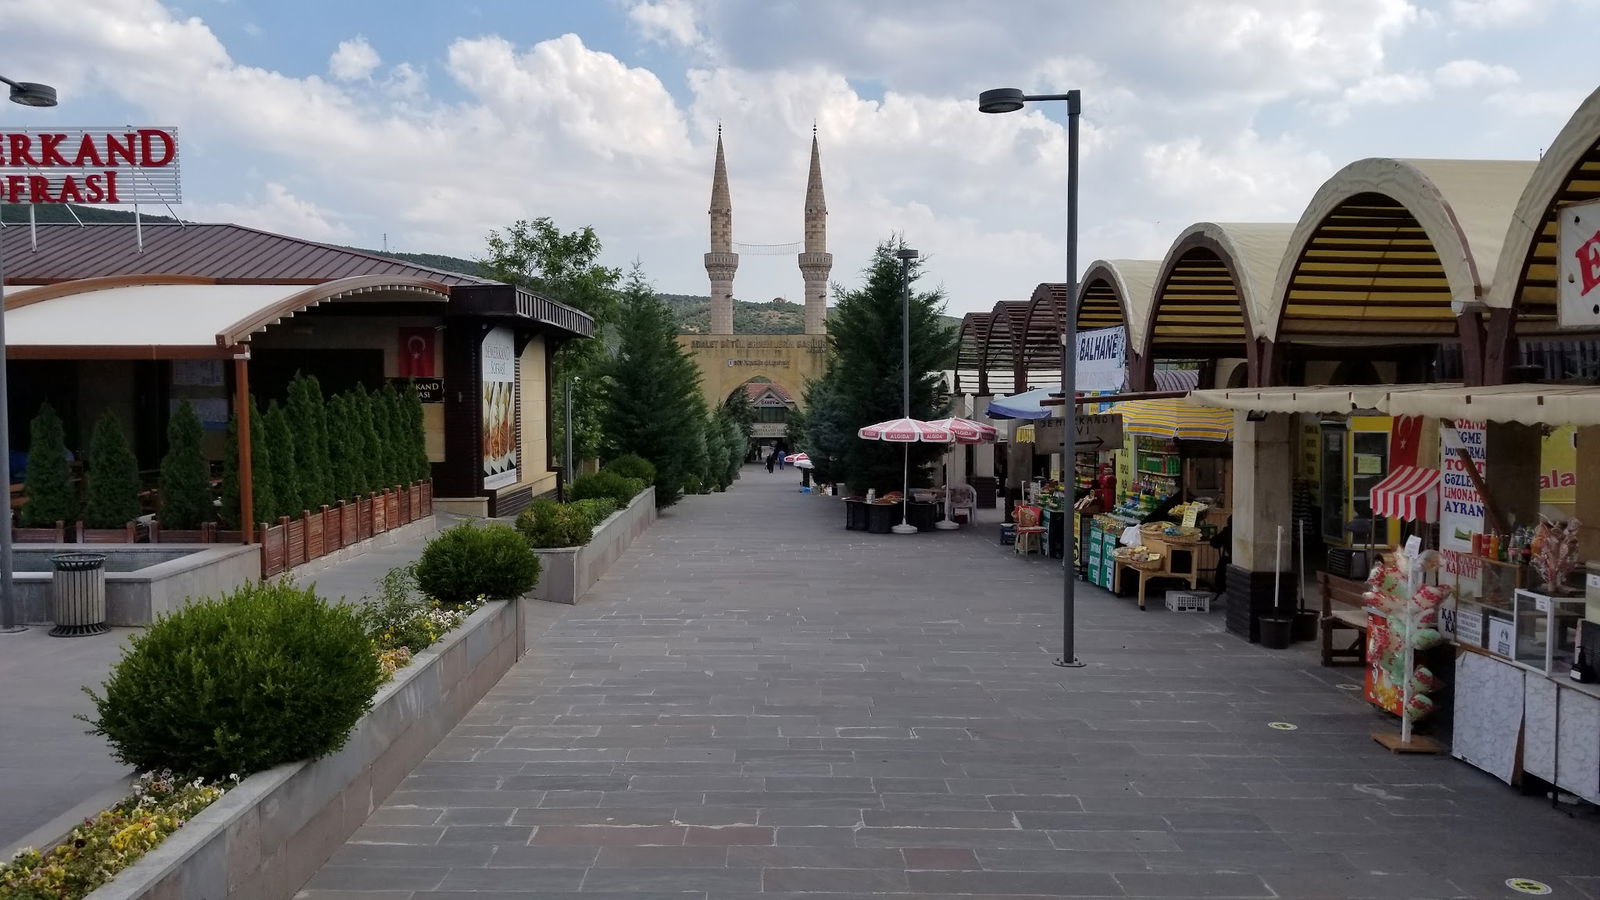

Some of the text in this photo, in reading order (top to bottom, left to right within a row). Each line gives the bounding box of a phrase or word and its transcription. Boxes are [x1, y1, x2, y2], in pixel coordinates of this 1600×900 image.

[0, 129, 176, 168] RKAND
[0, 170, 120, 203] FRASI
[1080, 333, 1118, 361] BALHANE
[1444, 458, 1486, 474] TOT
[1444, 473, 1474, 488] GÖZLE
[1444, 500, 1486, 518] AYRAN
